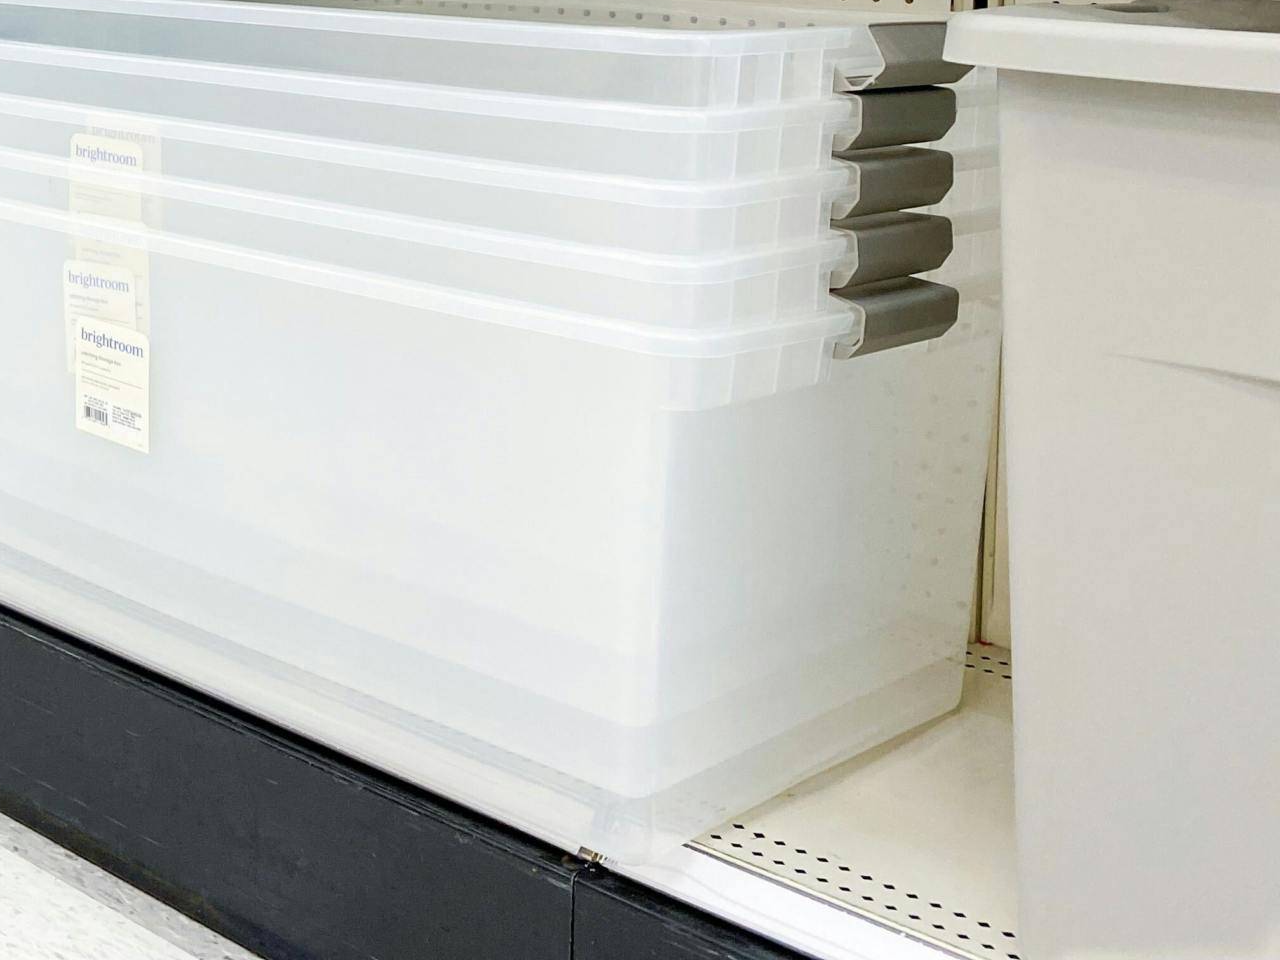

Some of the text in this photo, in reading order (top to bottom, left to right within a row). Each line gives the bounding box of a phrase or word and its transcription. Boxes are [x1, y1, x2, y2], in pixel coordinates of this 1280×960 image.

[75, 143, 137, 167] brightroom
[68, 269, 129, 293] brightroom
[81, 326, 144, 358] brightroom
